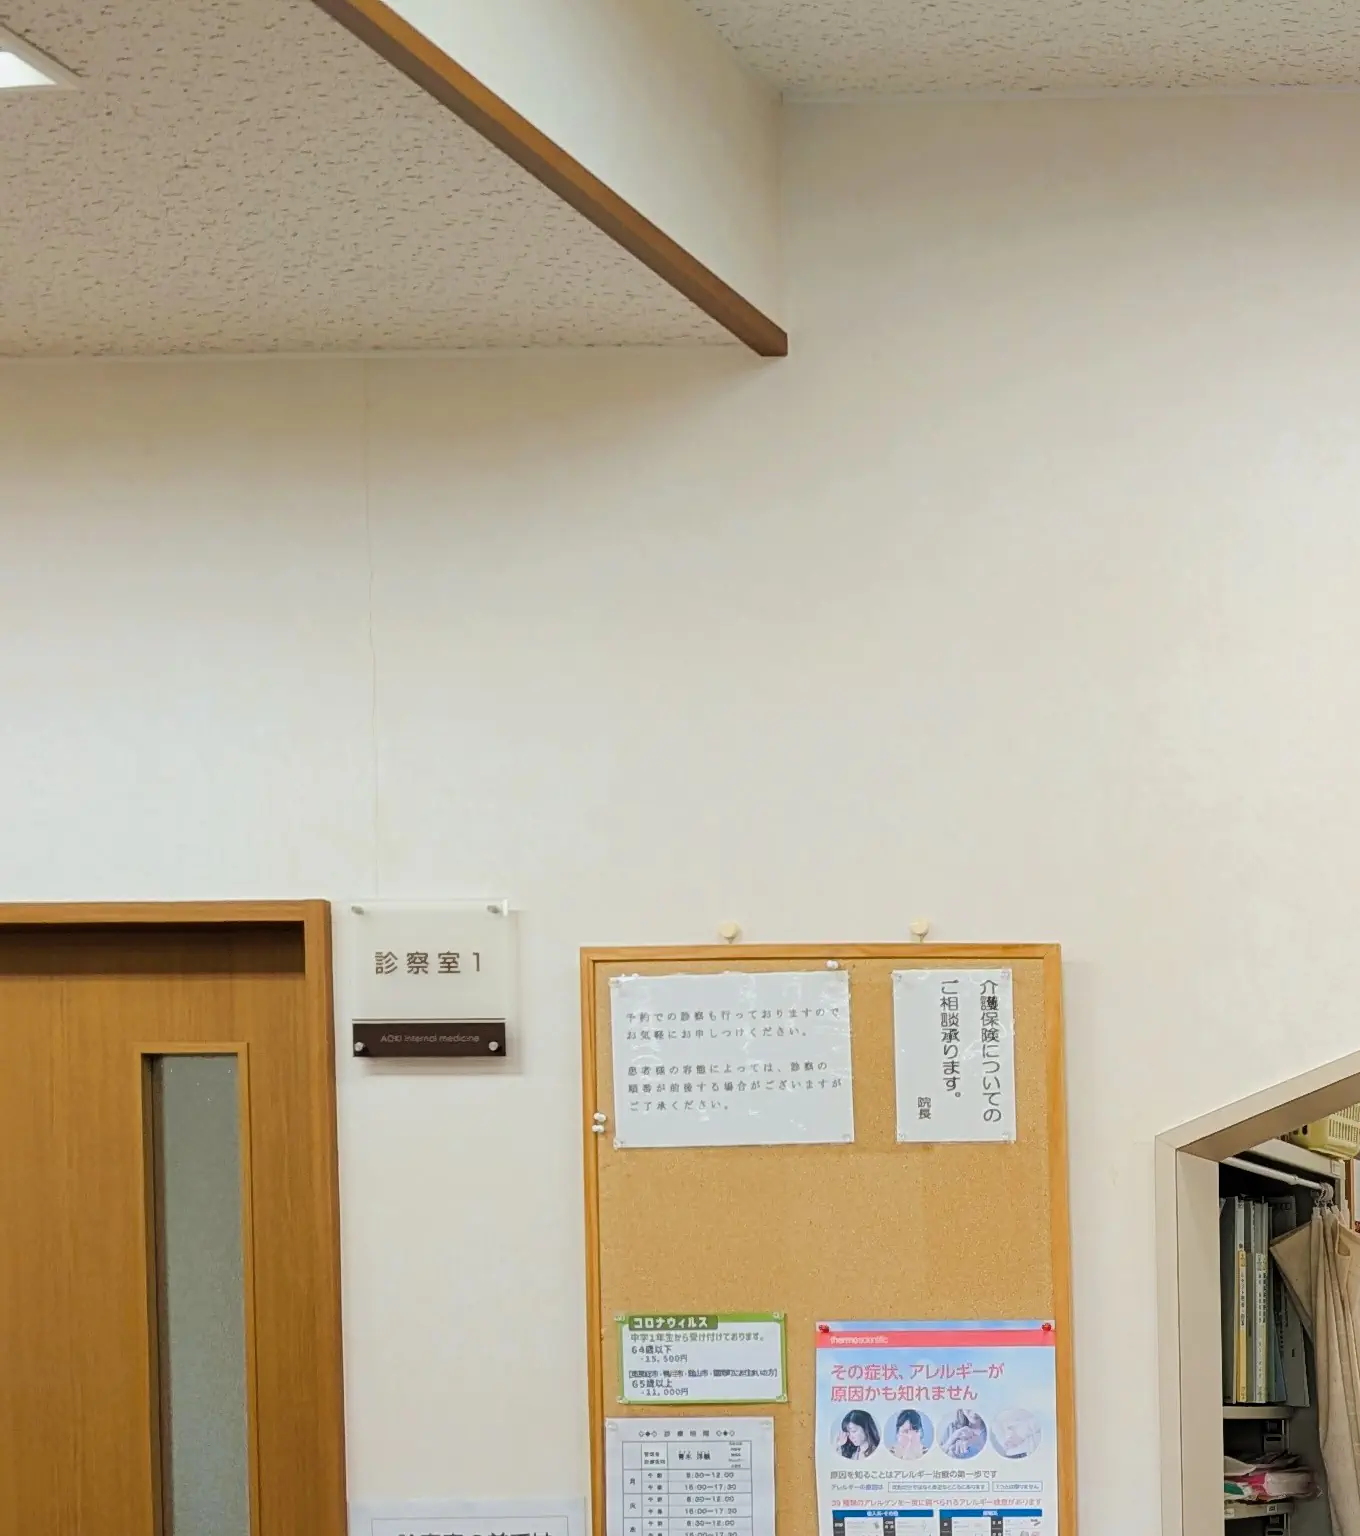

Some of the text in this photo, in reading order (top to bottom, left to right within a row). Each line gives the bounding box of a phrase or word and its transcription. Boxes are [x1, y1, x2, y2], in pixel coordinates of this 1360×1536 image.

[941, 979, 961, 1097] ご相談承ります。
[980, 980, 1002, 1122] 介護保険についての
[917, 1097, 931, 1120] 院長
[634, 1316, 708, 1328] コロナウィルス
[831, 1362, 1005, 1381] その症状、アレルギーが
[831, 1386, 978, 1402] 原因かも知れません
